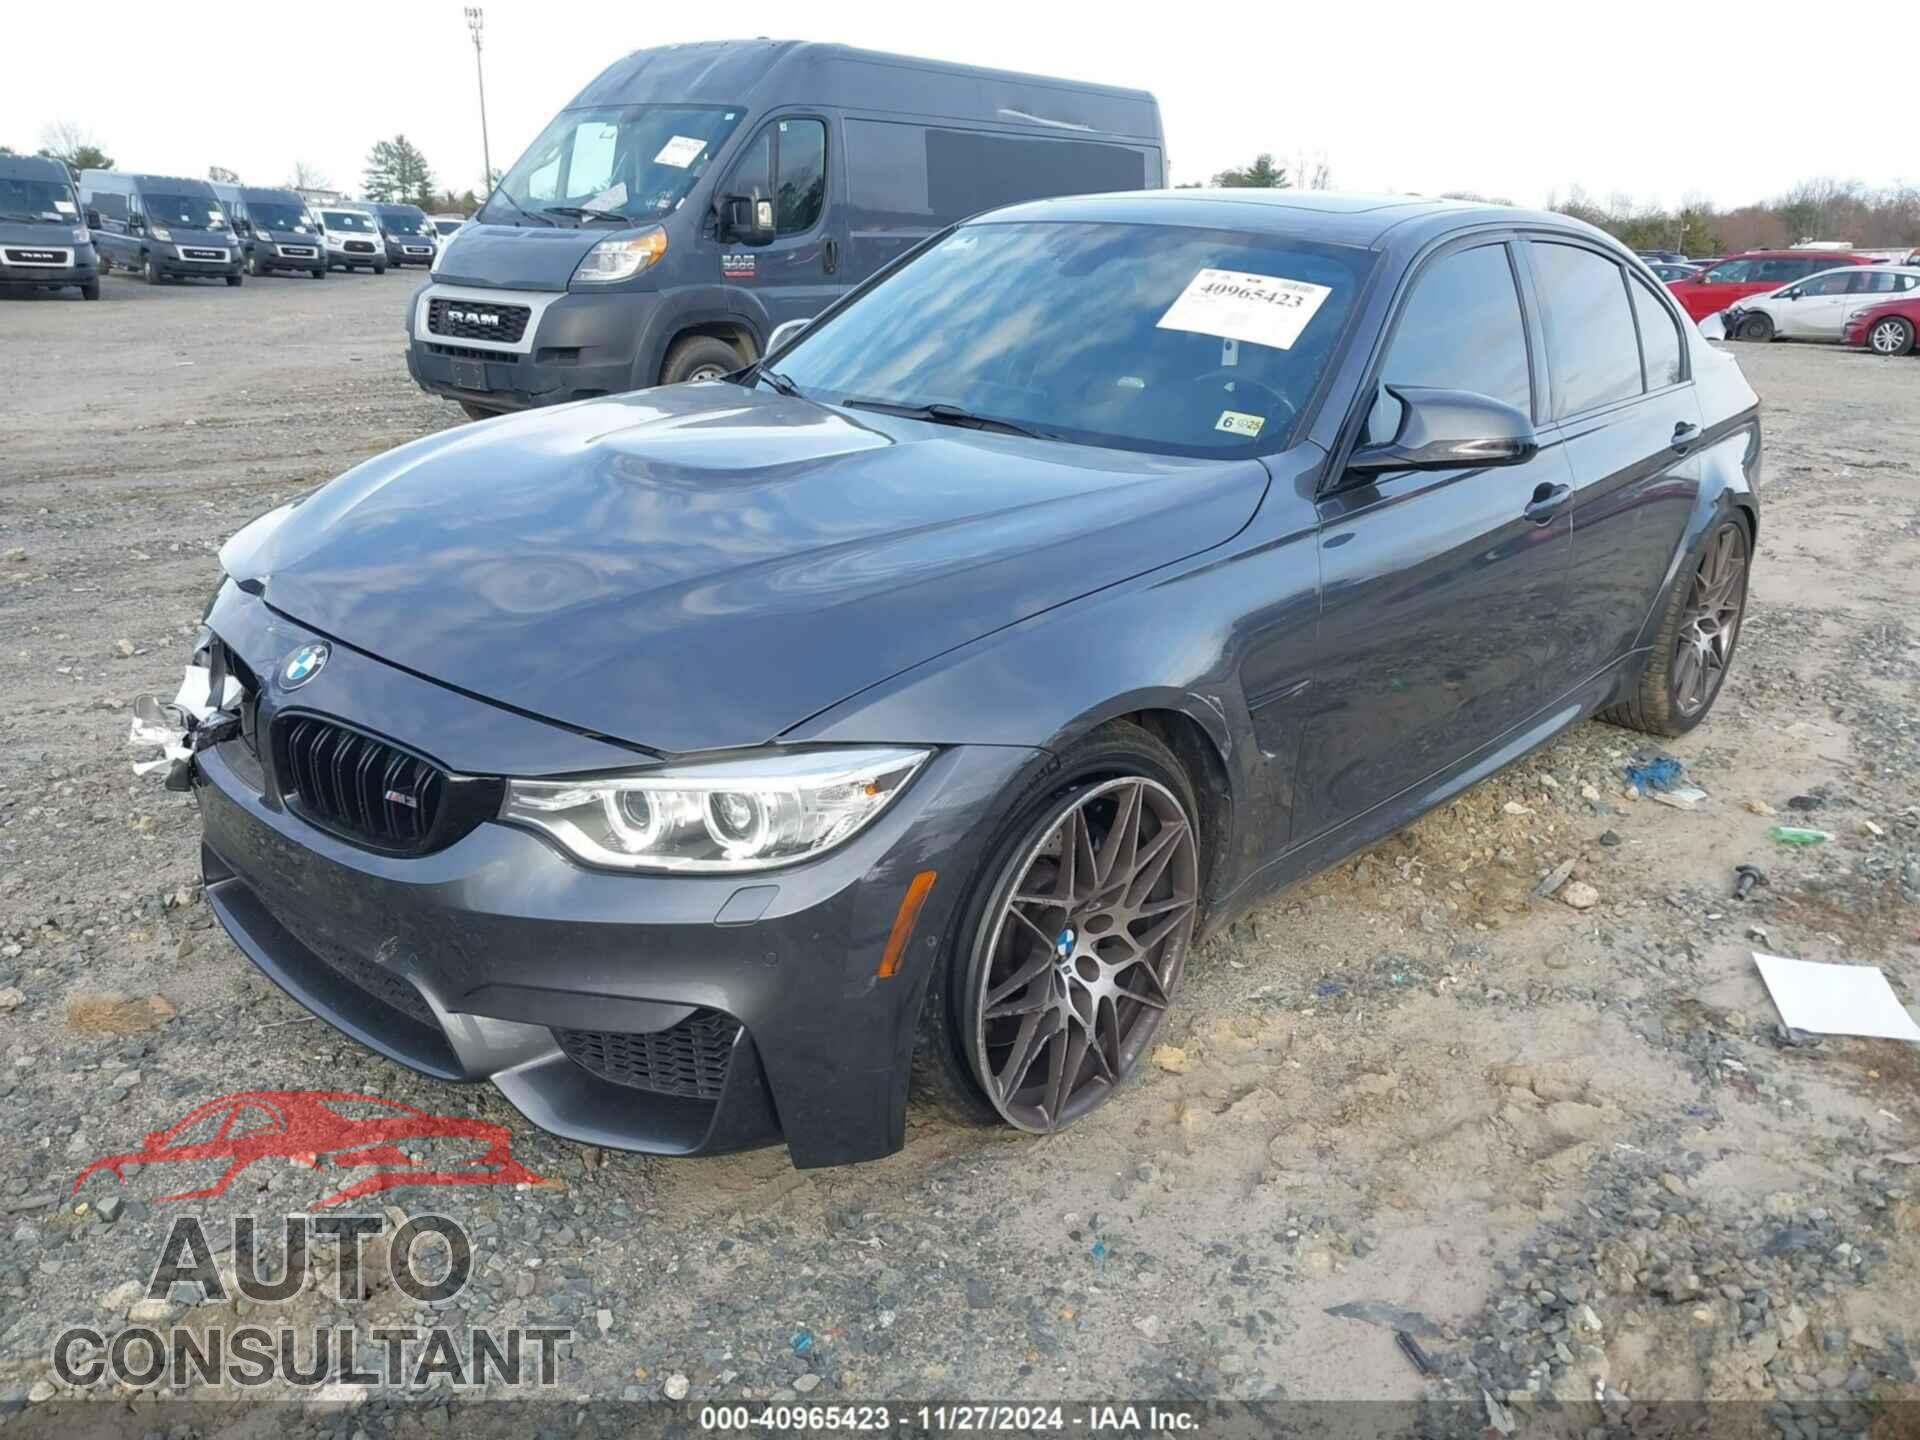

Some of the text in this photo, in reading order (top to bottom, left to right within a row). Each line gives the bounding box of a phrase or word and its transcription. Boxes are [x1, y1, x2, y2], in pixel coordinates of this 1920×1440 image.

[1200, 282, 1305, 309] 40965423
[447, 310, 499, 326] RAM
[1223, 416, 1235, 428] 6
